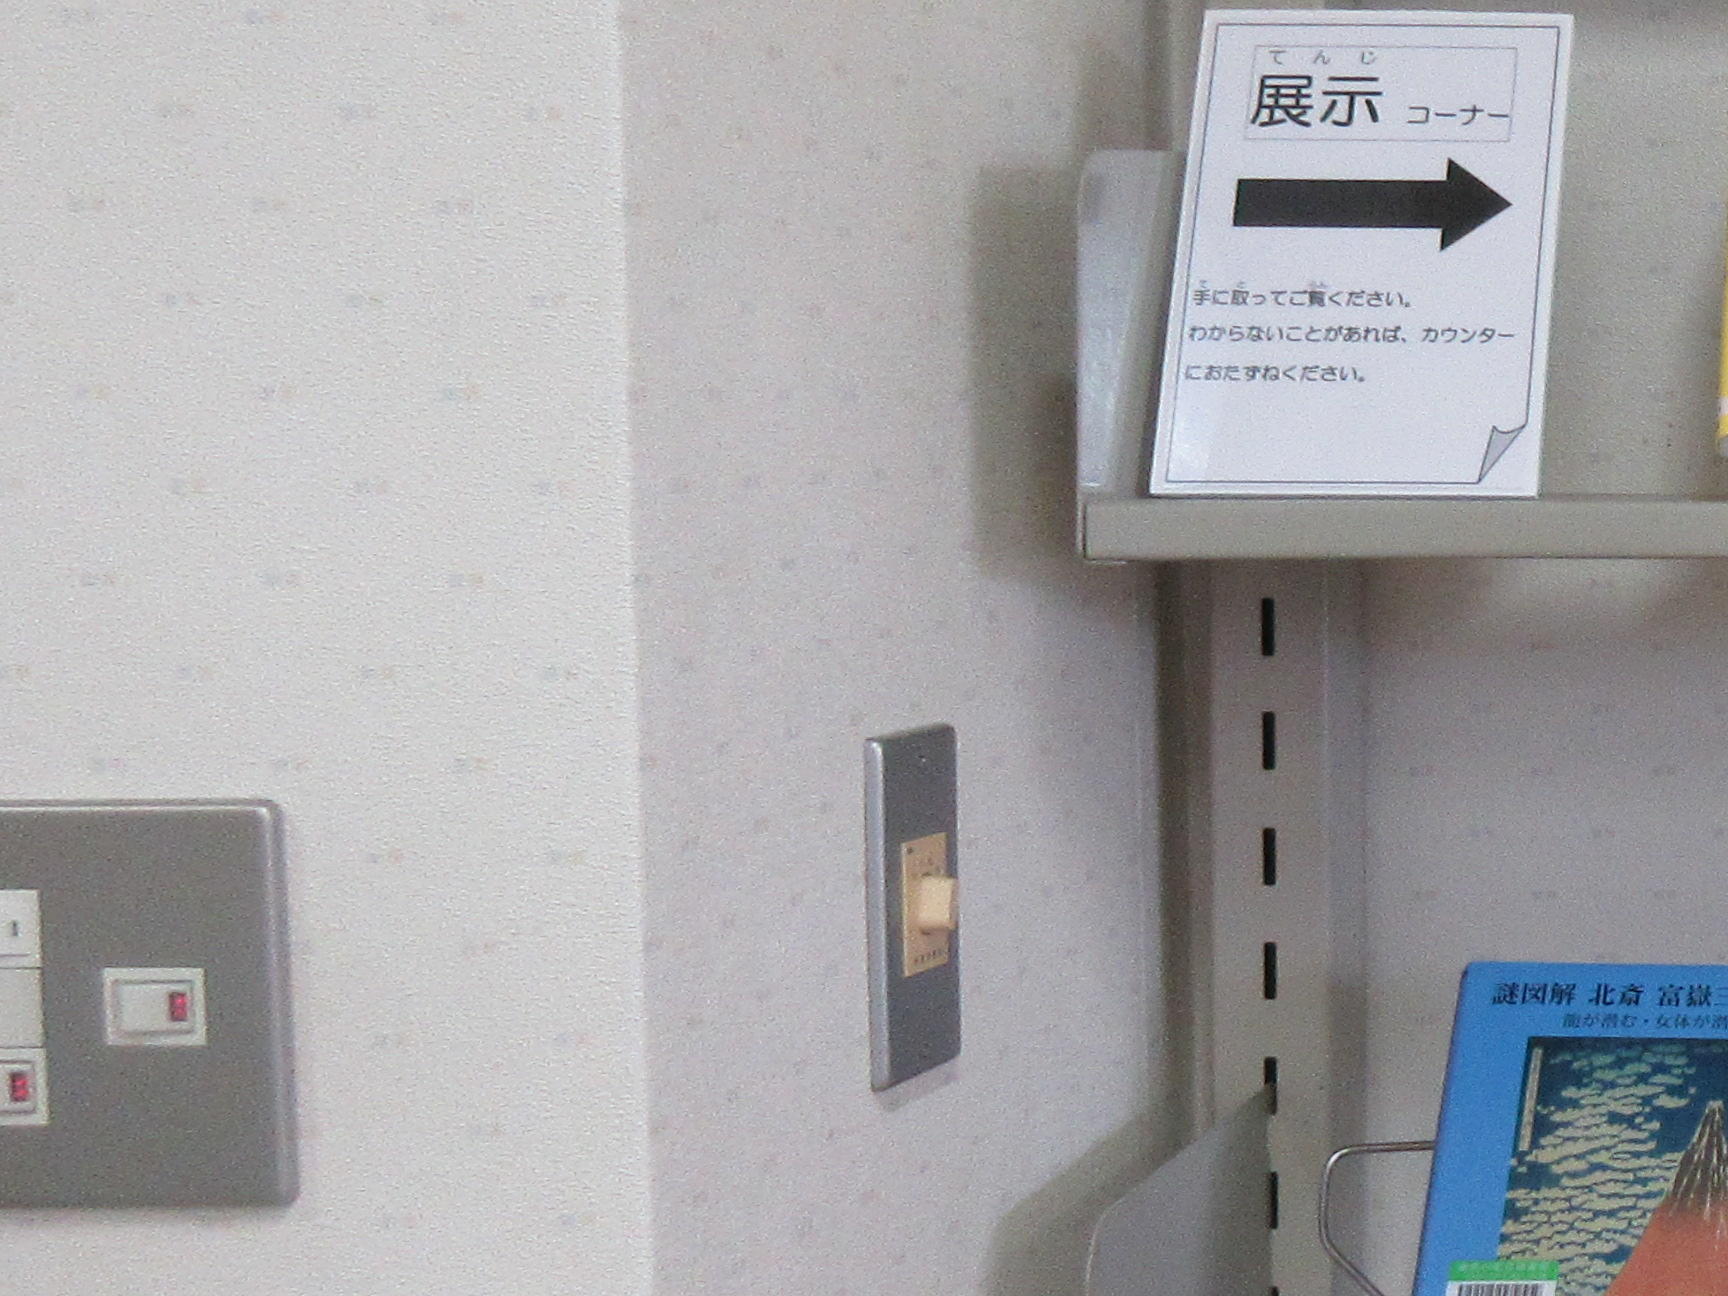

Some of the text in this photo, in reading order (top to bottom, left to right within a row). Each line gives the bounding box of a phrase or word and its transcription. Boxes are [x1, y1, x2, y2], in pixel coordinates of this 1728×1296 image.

[1251, 74, 1509, 127] 展示 コーナー
[1492, 983, 1576, 1005] 謎図解
[1588, 983, 1644, 1005] 北斎
